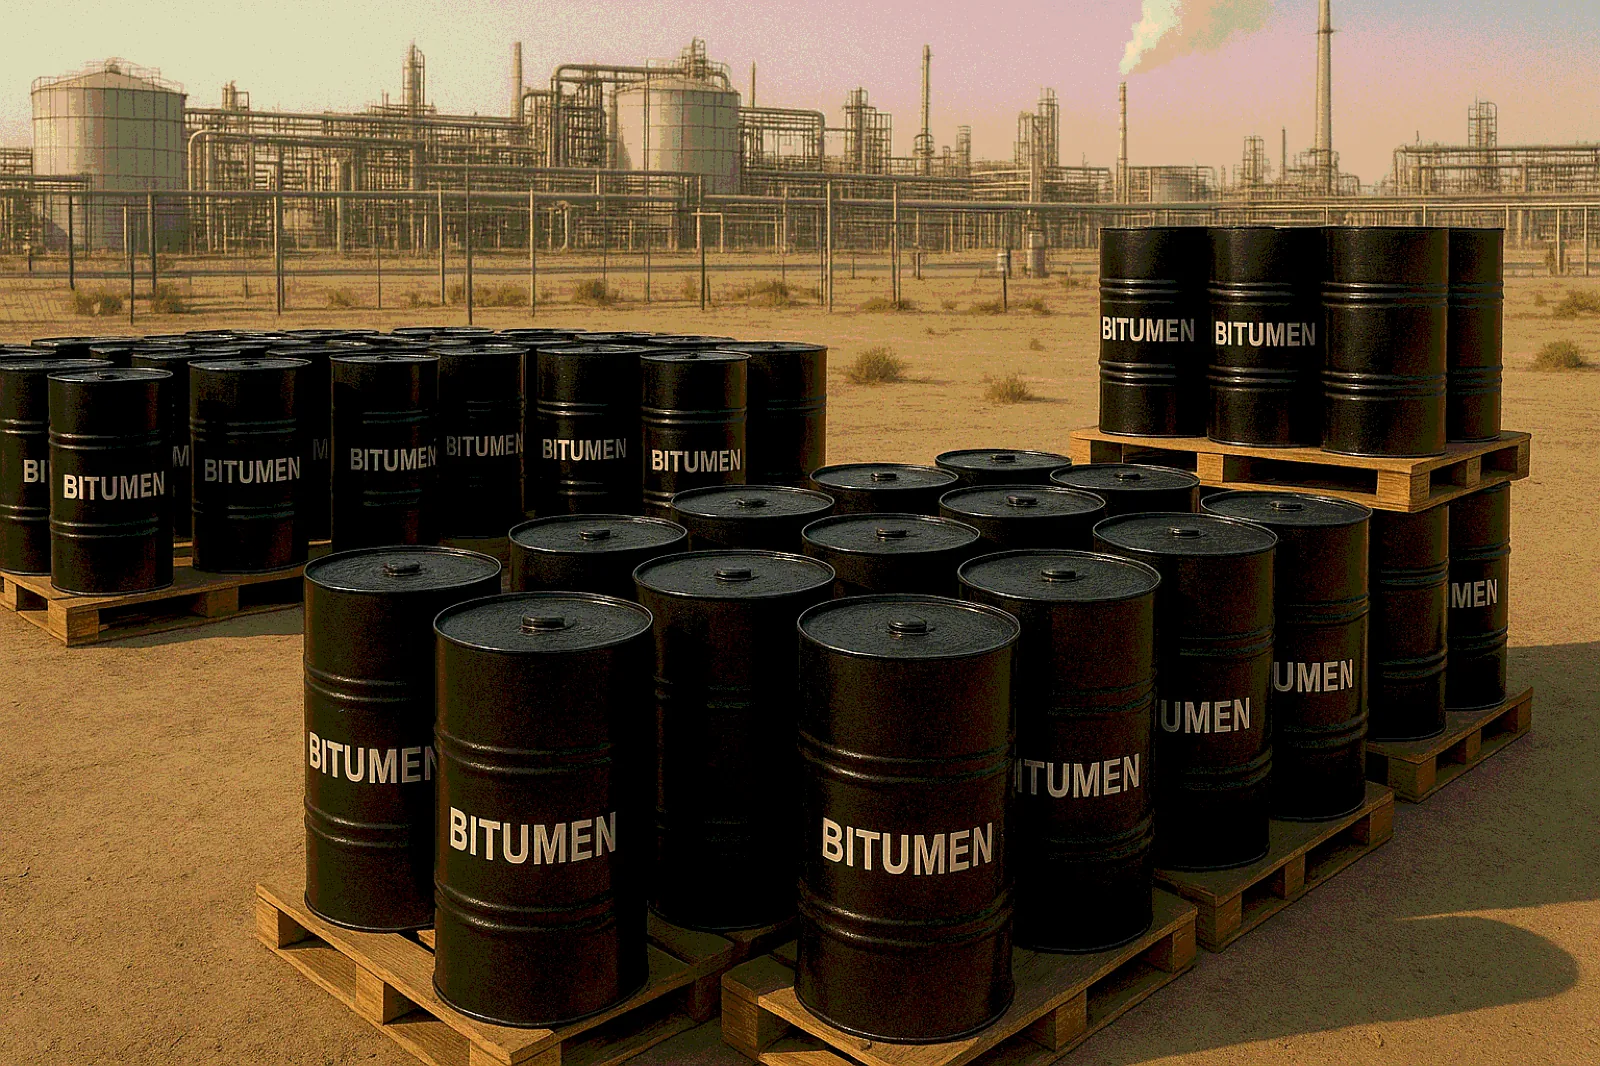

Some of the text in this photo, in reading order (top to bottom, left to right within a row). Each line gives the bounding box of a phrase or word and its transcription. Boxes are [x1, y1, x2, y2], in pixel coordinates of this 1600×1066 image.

[1102, 316, 1195, 343] BITUMEN
[1215, 321, 1316, 347] BITUMEN
[349, 445, 437, 472] BITUMEN
[444, 432, 522, 457] BITUMEN
[541, 437, 627, 462] BITUMEN
[204, 456, 301, 484] BITUMEN
[651, 448, 742, 474] BITUMEN
[63, 470, 165, 500] BITUMEN
[1273, 659, 1354, 694] UMEN
[1160, 697, 1251, 734] UMEN
[308, 731, 436, 785] BITUMEN
[1011, 753, 1141, 799] ITUMEN
[449, 807, 617, 866] BITUMEN
[821, 818, 993, 876] BITUMEN
